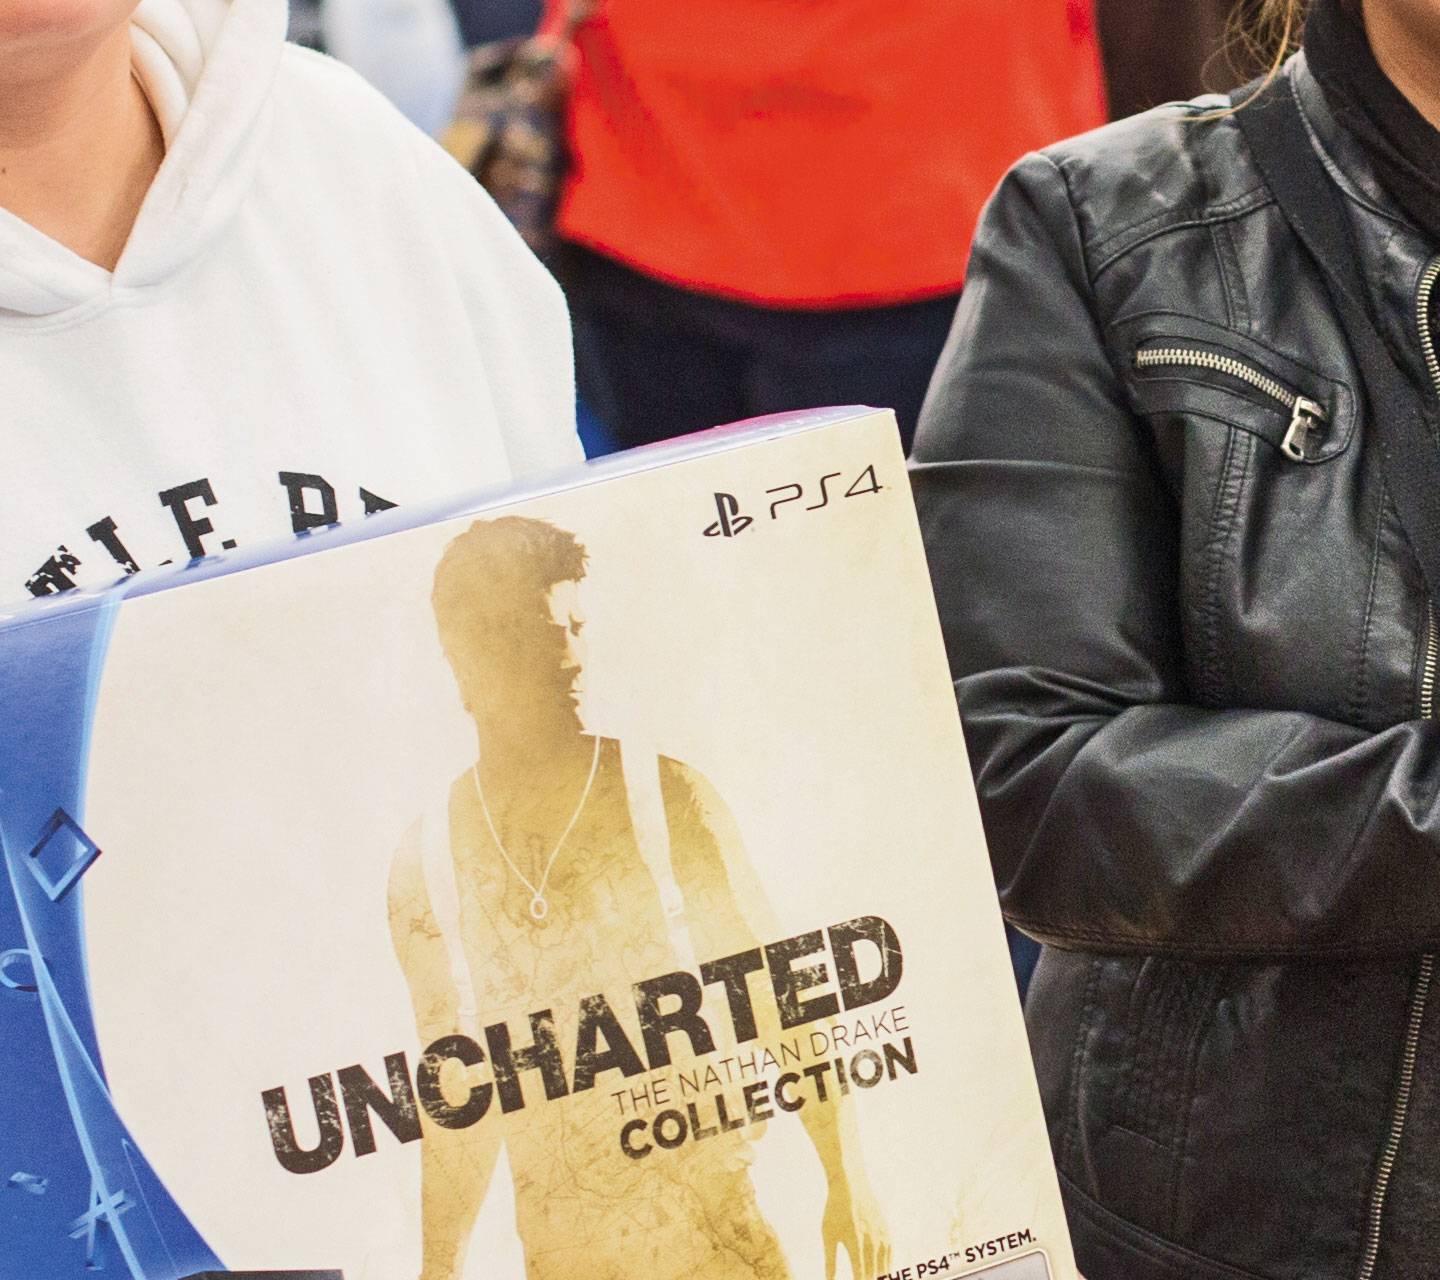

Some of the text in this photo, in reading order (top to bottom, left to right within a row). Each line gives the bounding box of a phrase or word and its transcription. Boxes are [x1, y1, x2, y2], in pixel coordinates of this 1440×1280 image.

[765, 464, 884, 520] PS4
[261, 915, 904, 1175] UNCHARTED
[609, 1005, 909, 1115] THE NATHAN DRAKE
[619, 1036, 920, 1161] COLLECTION
